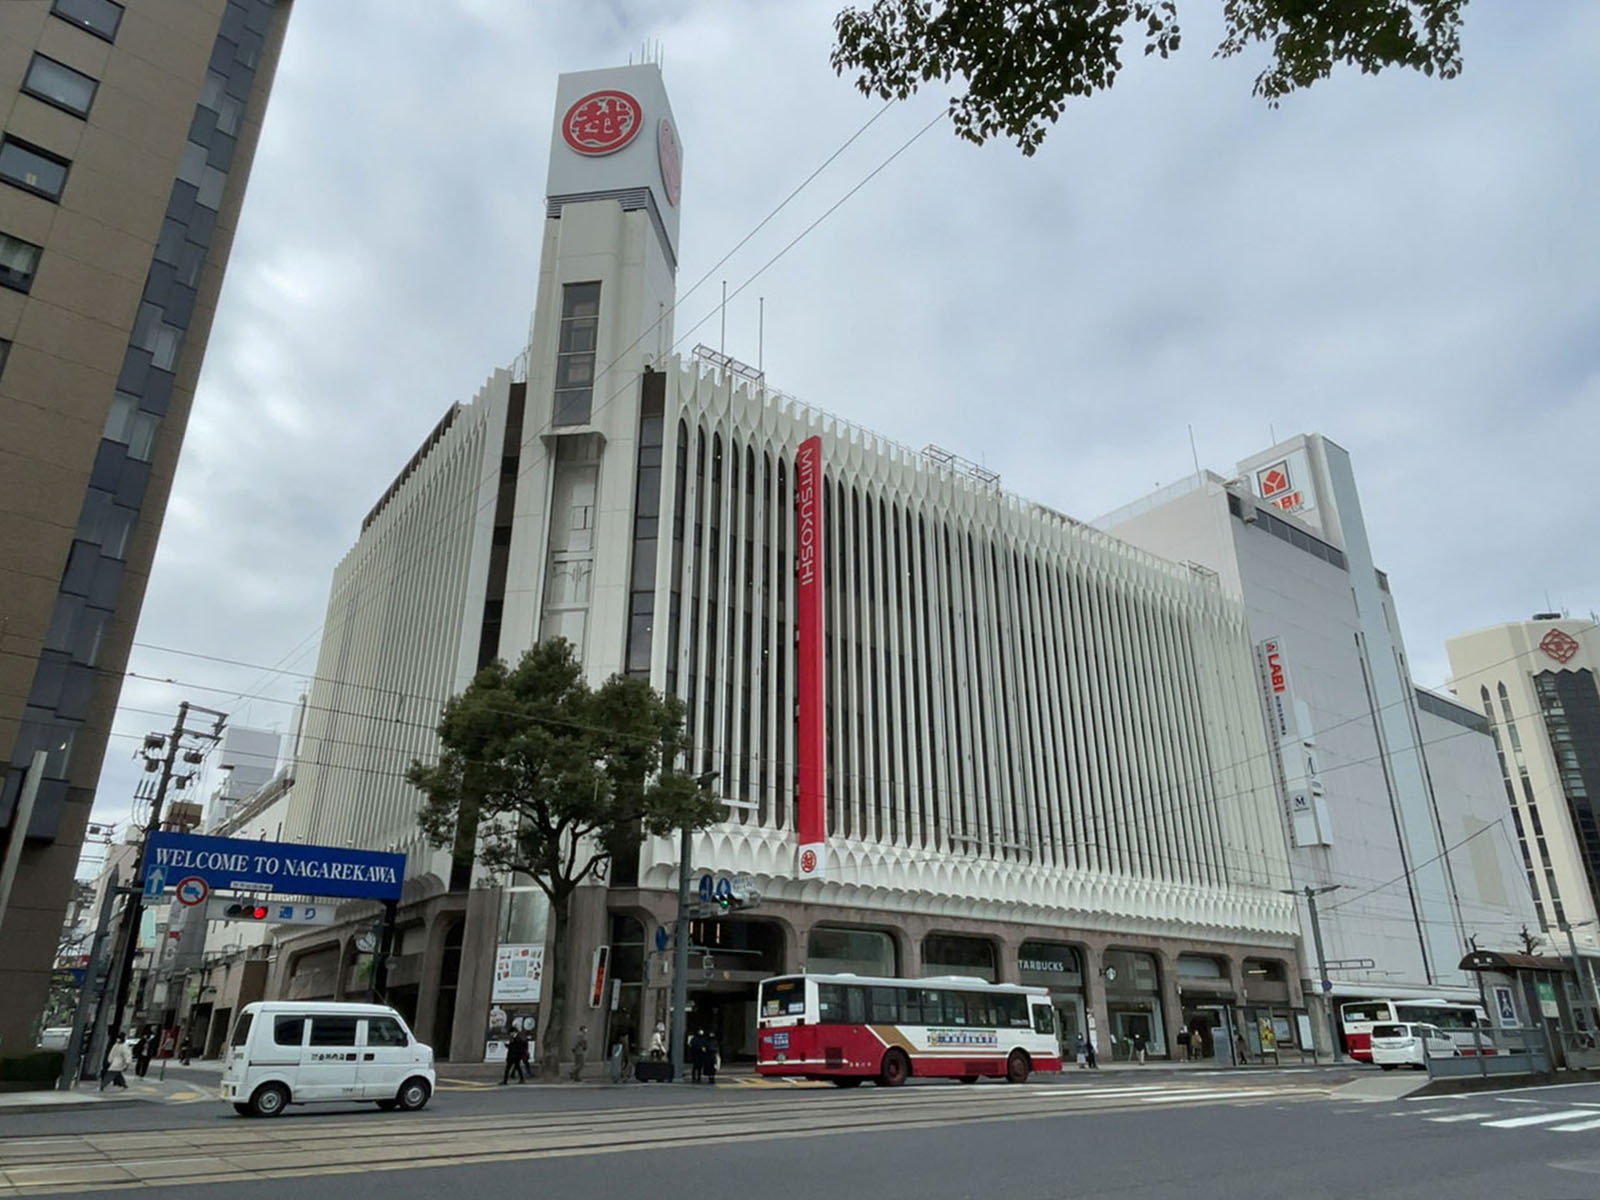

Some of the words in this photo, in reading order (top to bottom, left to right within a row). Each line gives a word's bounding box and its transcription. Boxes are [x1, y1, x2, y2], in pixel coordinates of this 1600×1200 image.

[800, 447, 814, 587] MITSUKOSHI
[1267, 653, 1286, 693] LABI
[156, 848, 249, 873] WELCOME
[254, 856, 279, 875] TO
[282, 858, 397, 884] NAGAREKAWA
[1018, 959, 1064, 972] TARBUCKS
